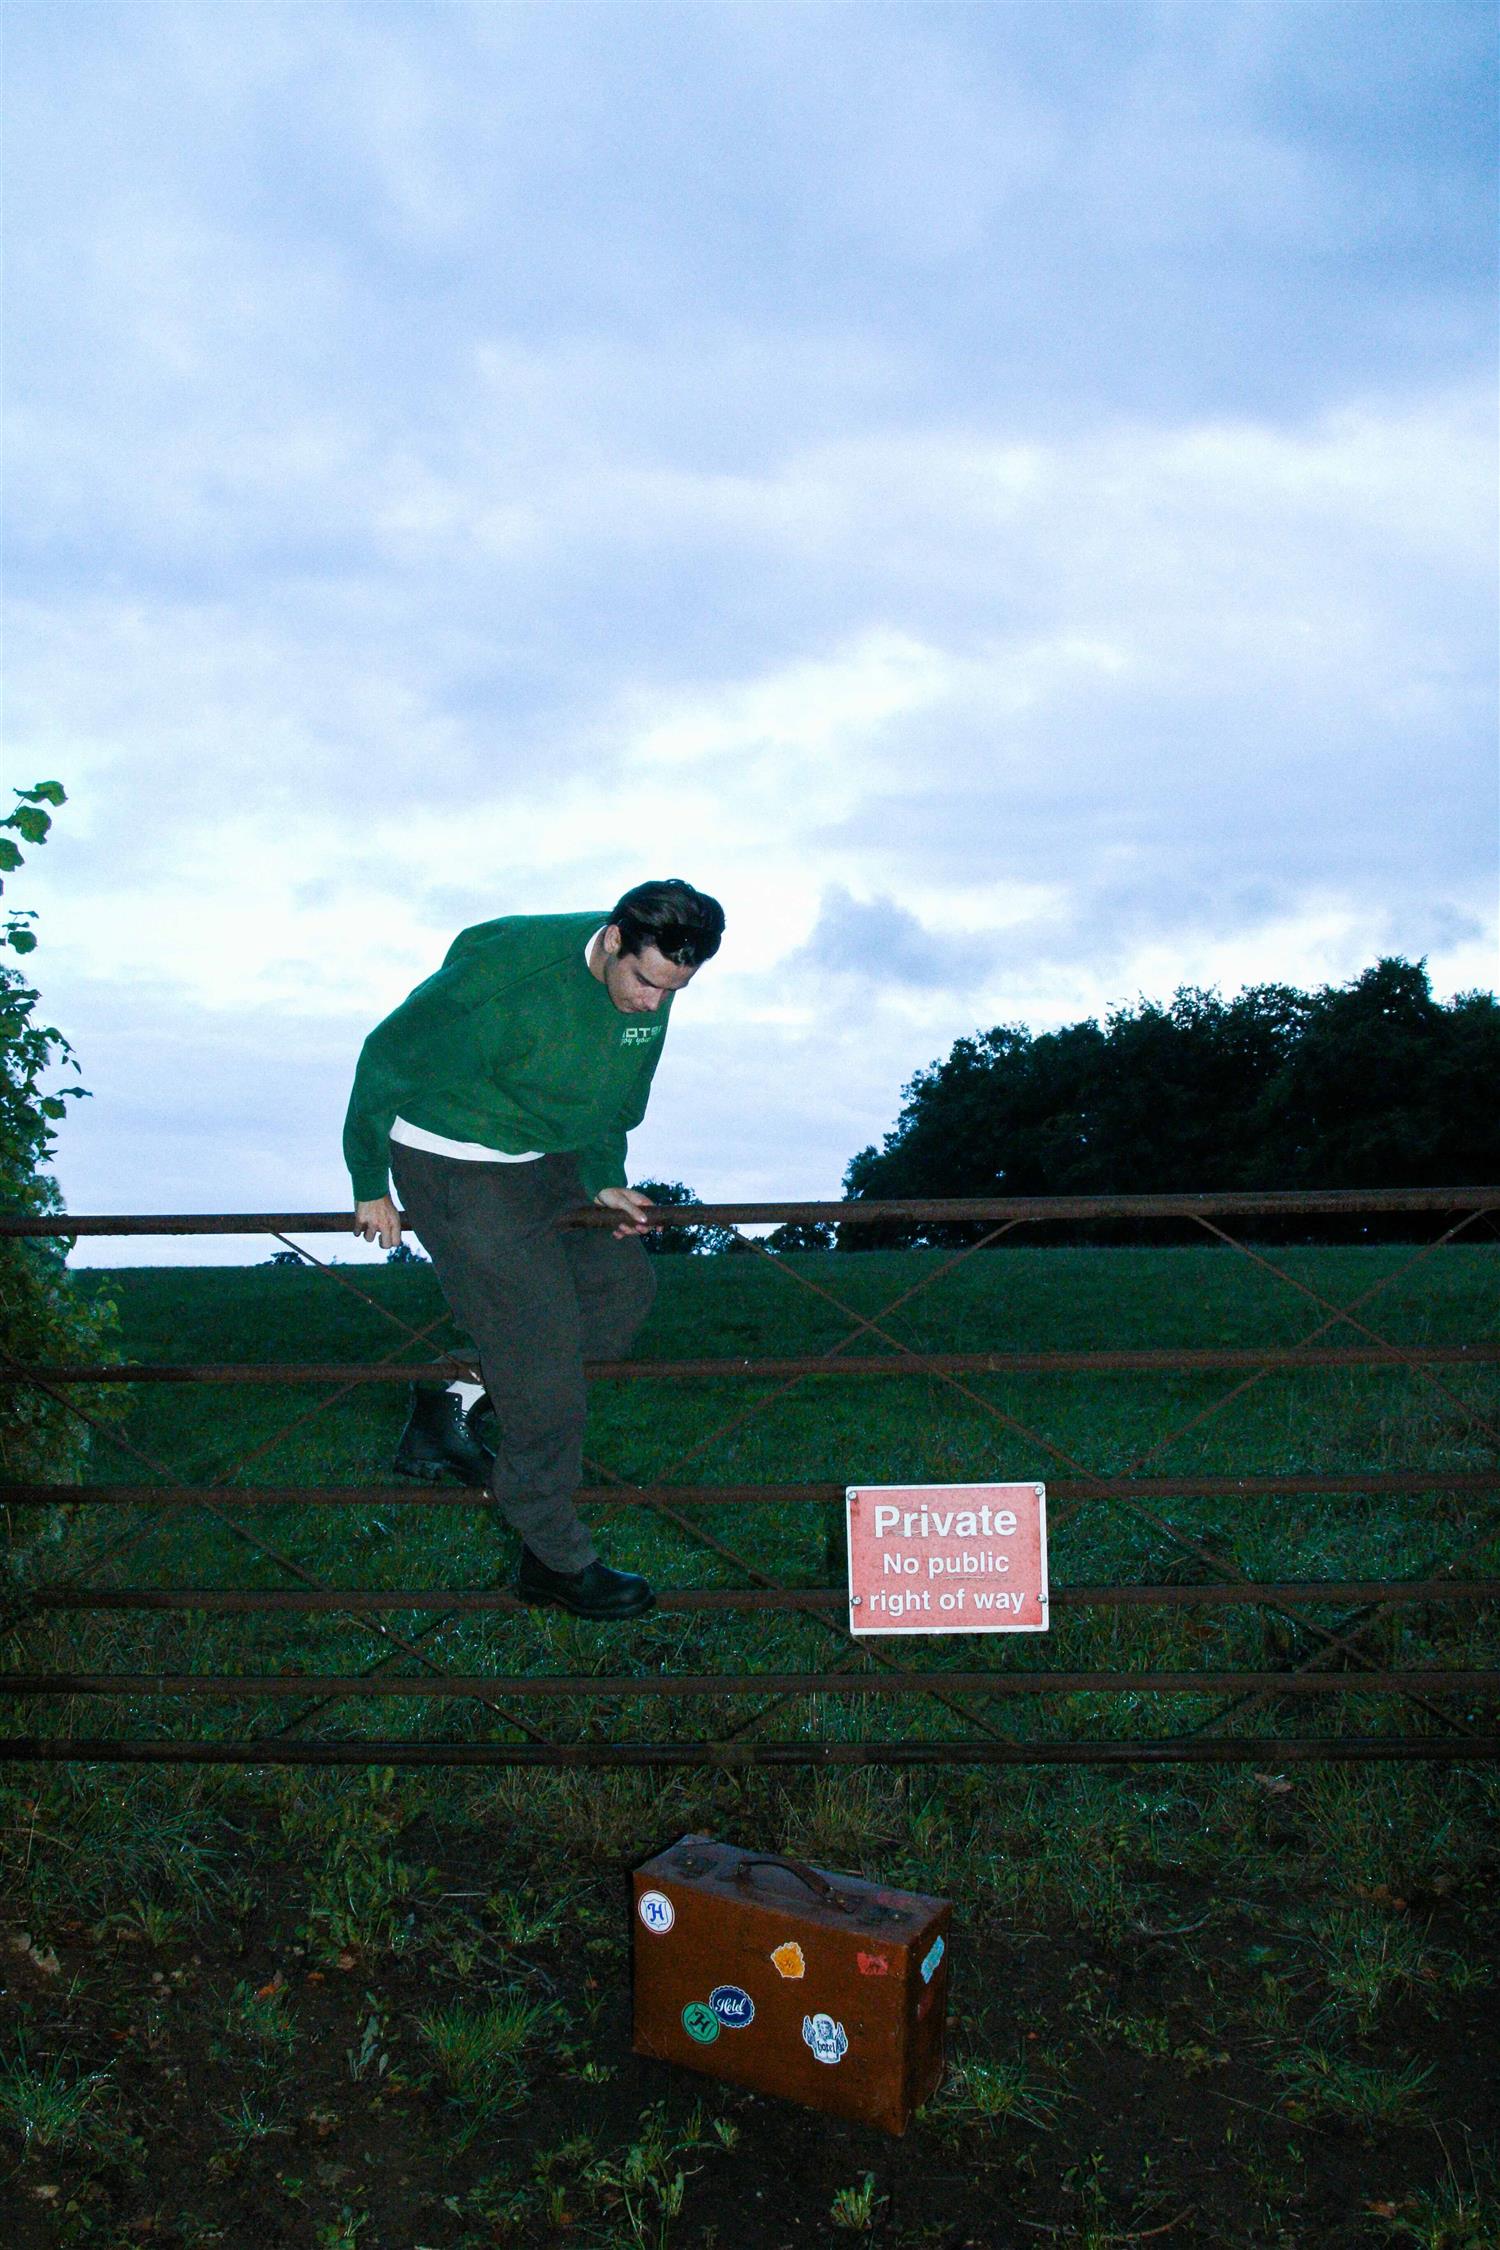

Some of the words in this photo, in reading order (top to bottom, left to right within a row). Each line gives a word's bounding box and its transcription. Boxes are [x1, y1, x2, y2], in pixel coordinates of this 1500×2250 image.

[874, 1504, 1018, 1538] Private
[883, 1553, 920, 1575] No
[928, 1551, 1010, 1580] public
[869, 1589, 931, 1617] right
[939, 1588, 966, 1611] of
[974, 1592, 1025, 1615] way
[647, 1903, 664, 1922] H
[715, 1997, 747, 2016] Hotel
